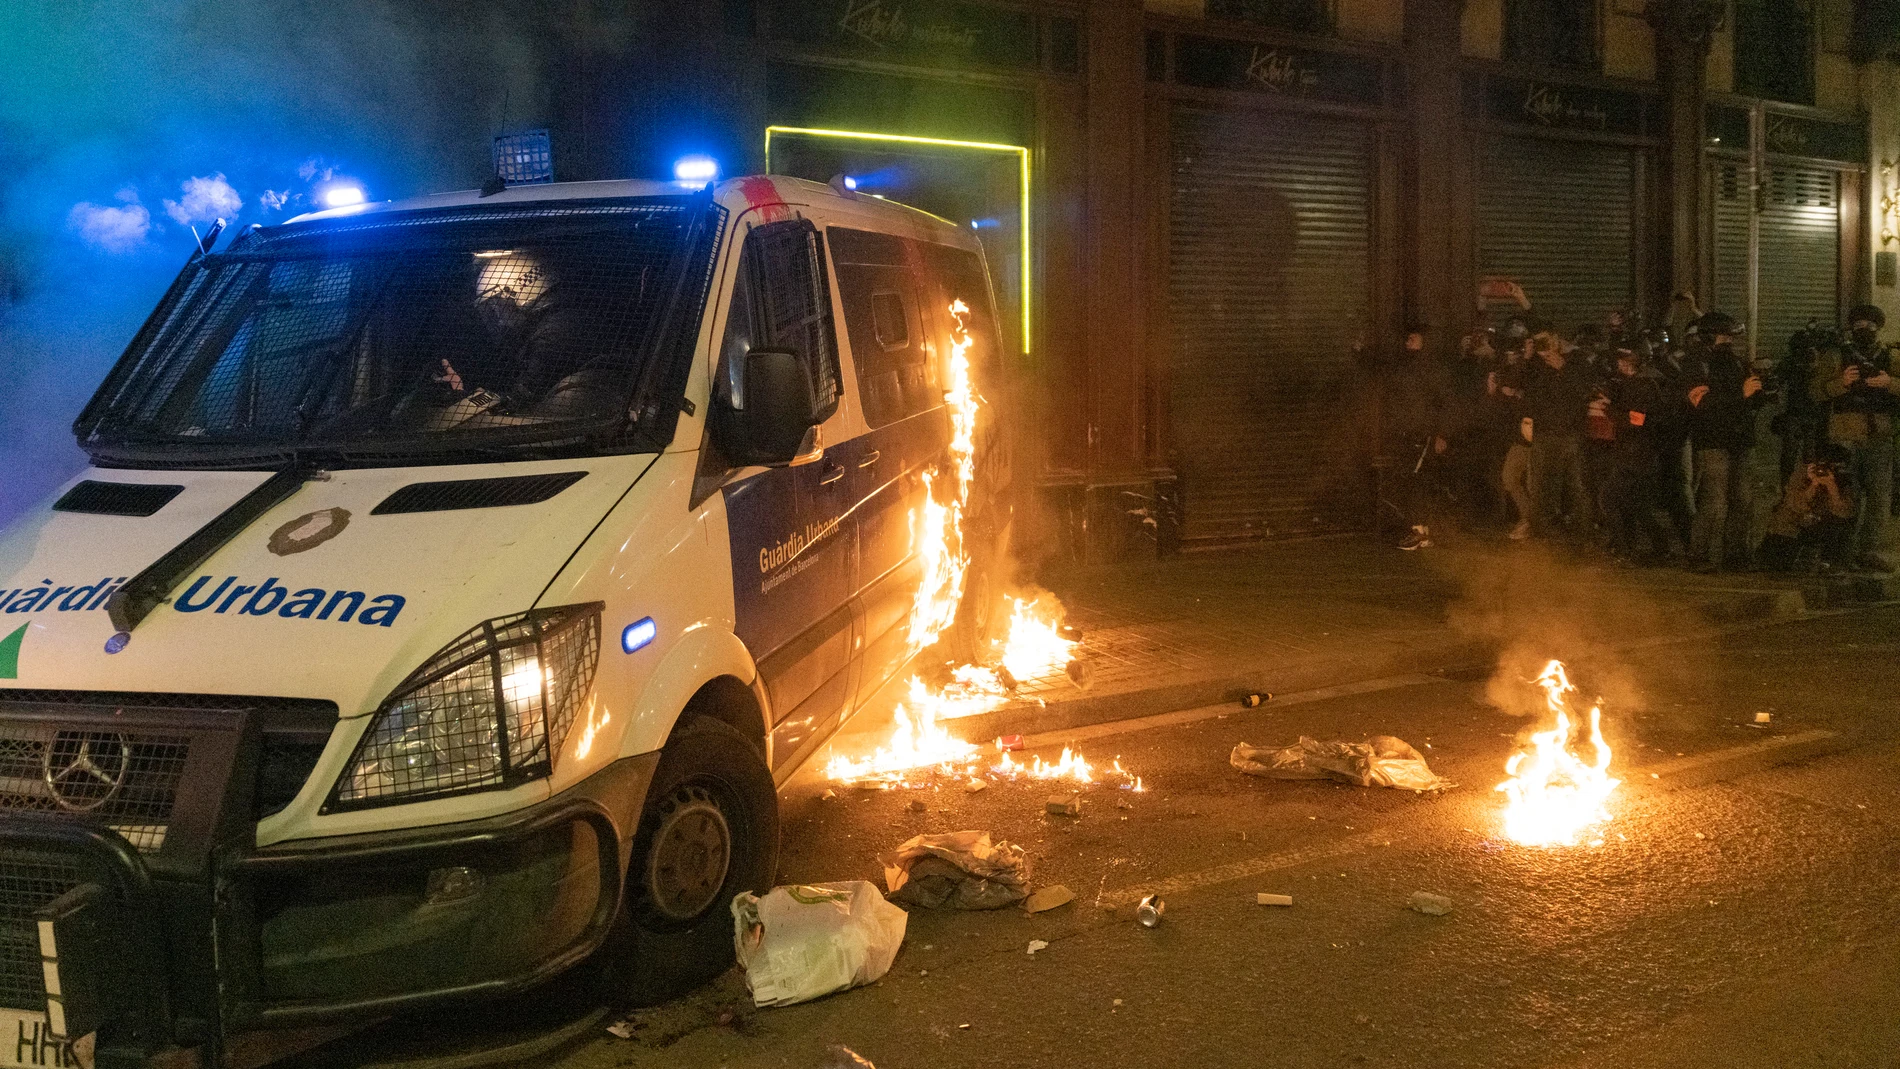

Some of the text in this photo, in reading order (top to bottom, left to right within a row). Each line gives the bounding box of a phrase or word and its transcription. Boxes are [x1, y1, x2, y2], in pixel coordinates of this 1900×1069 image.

[760, 515, 840, 573] Guàrdia Urbana
[761, 553, 819, 595] Ajuntament de Barcelona
[0, 575, 407, 628] uàrdi Urbana
